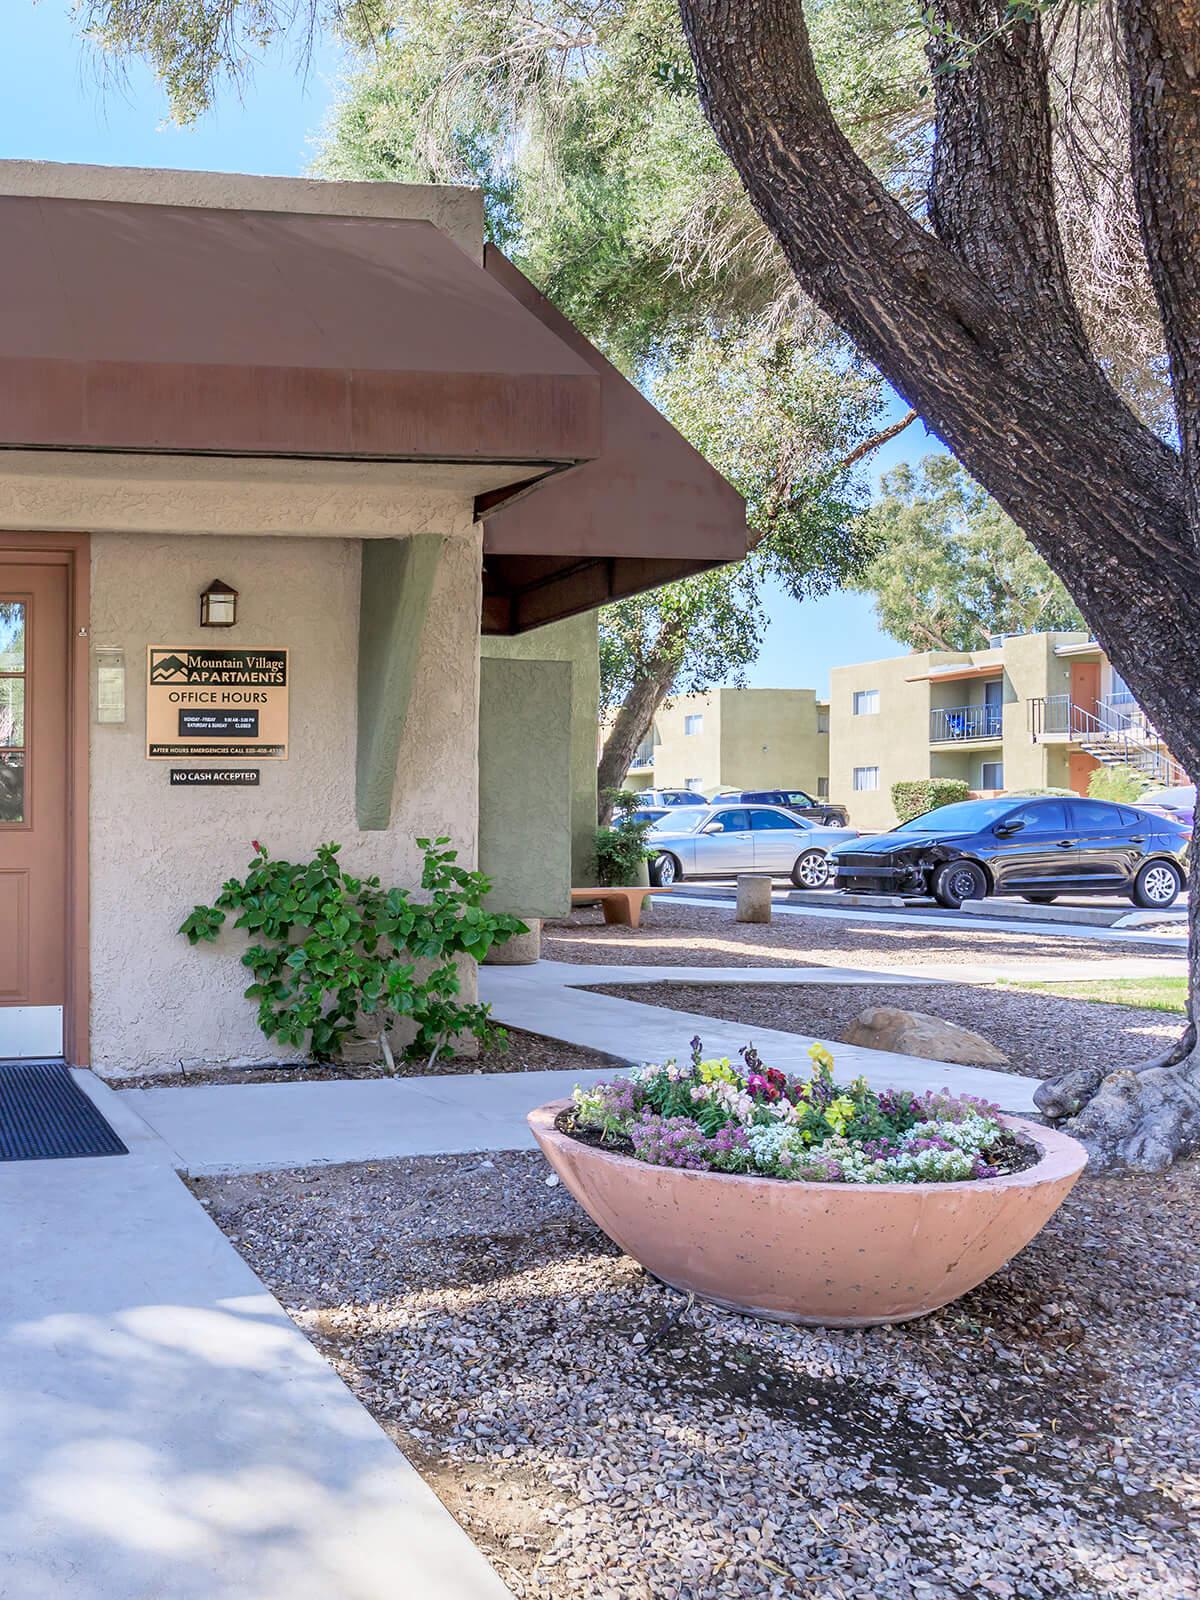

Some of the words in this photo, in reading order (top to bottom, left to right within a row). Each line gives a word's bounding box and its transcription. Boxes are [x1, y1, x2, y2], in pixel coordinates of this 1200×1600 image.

[188, 656, 243, 669] Mountain
[246, 657, 284, 672] Village
[190, 672, 284, 683] APARTMENTS
[168, 692, 217, 703] OFFICE
[221, 692, 268, 703] HOURS
[173, 772, 186, 780] NO
[188, 772, 211, 780] CASH
[213, 772, 256, 780] ACCEPTED
